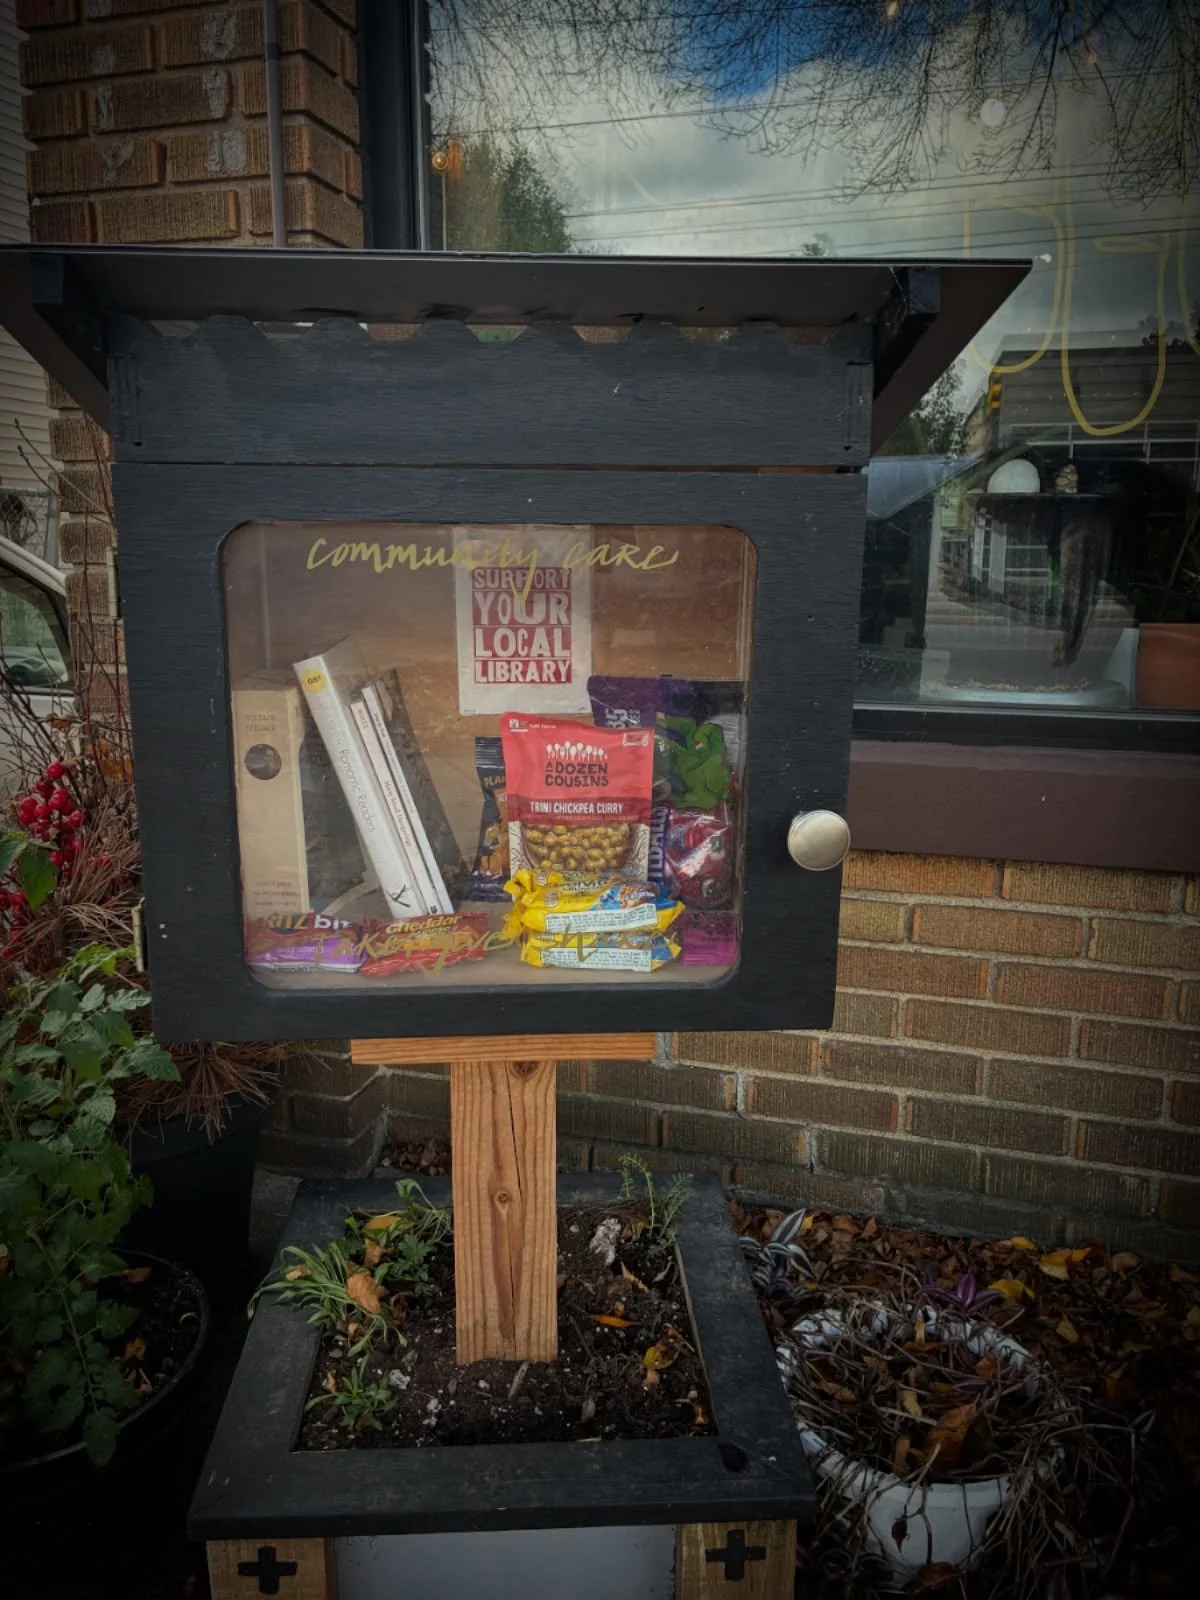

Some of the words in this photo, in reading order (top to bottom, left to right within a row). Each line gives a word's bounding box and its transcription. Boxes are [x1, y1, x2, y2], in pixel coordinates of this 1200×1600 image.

[474, 568, 571, 589] SUPPORT
[474, 591, 570, 625] YOUR
[475, 627, 570, 658] LOCAL
[475, 660, 570, 682] LIBRARY
[545, 761, 553, 773] A
[556, 762, 608, 775] DOZEN
[545, 774, 609, 788] COUSINS
[530, 801, 551, 813] TRINI
[553, 802, 594, 814] CHICKPEA
[597, 803, 624, 814] CURRY
